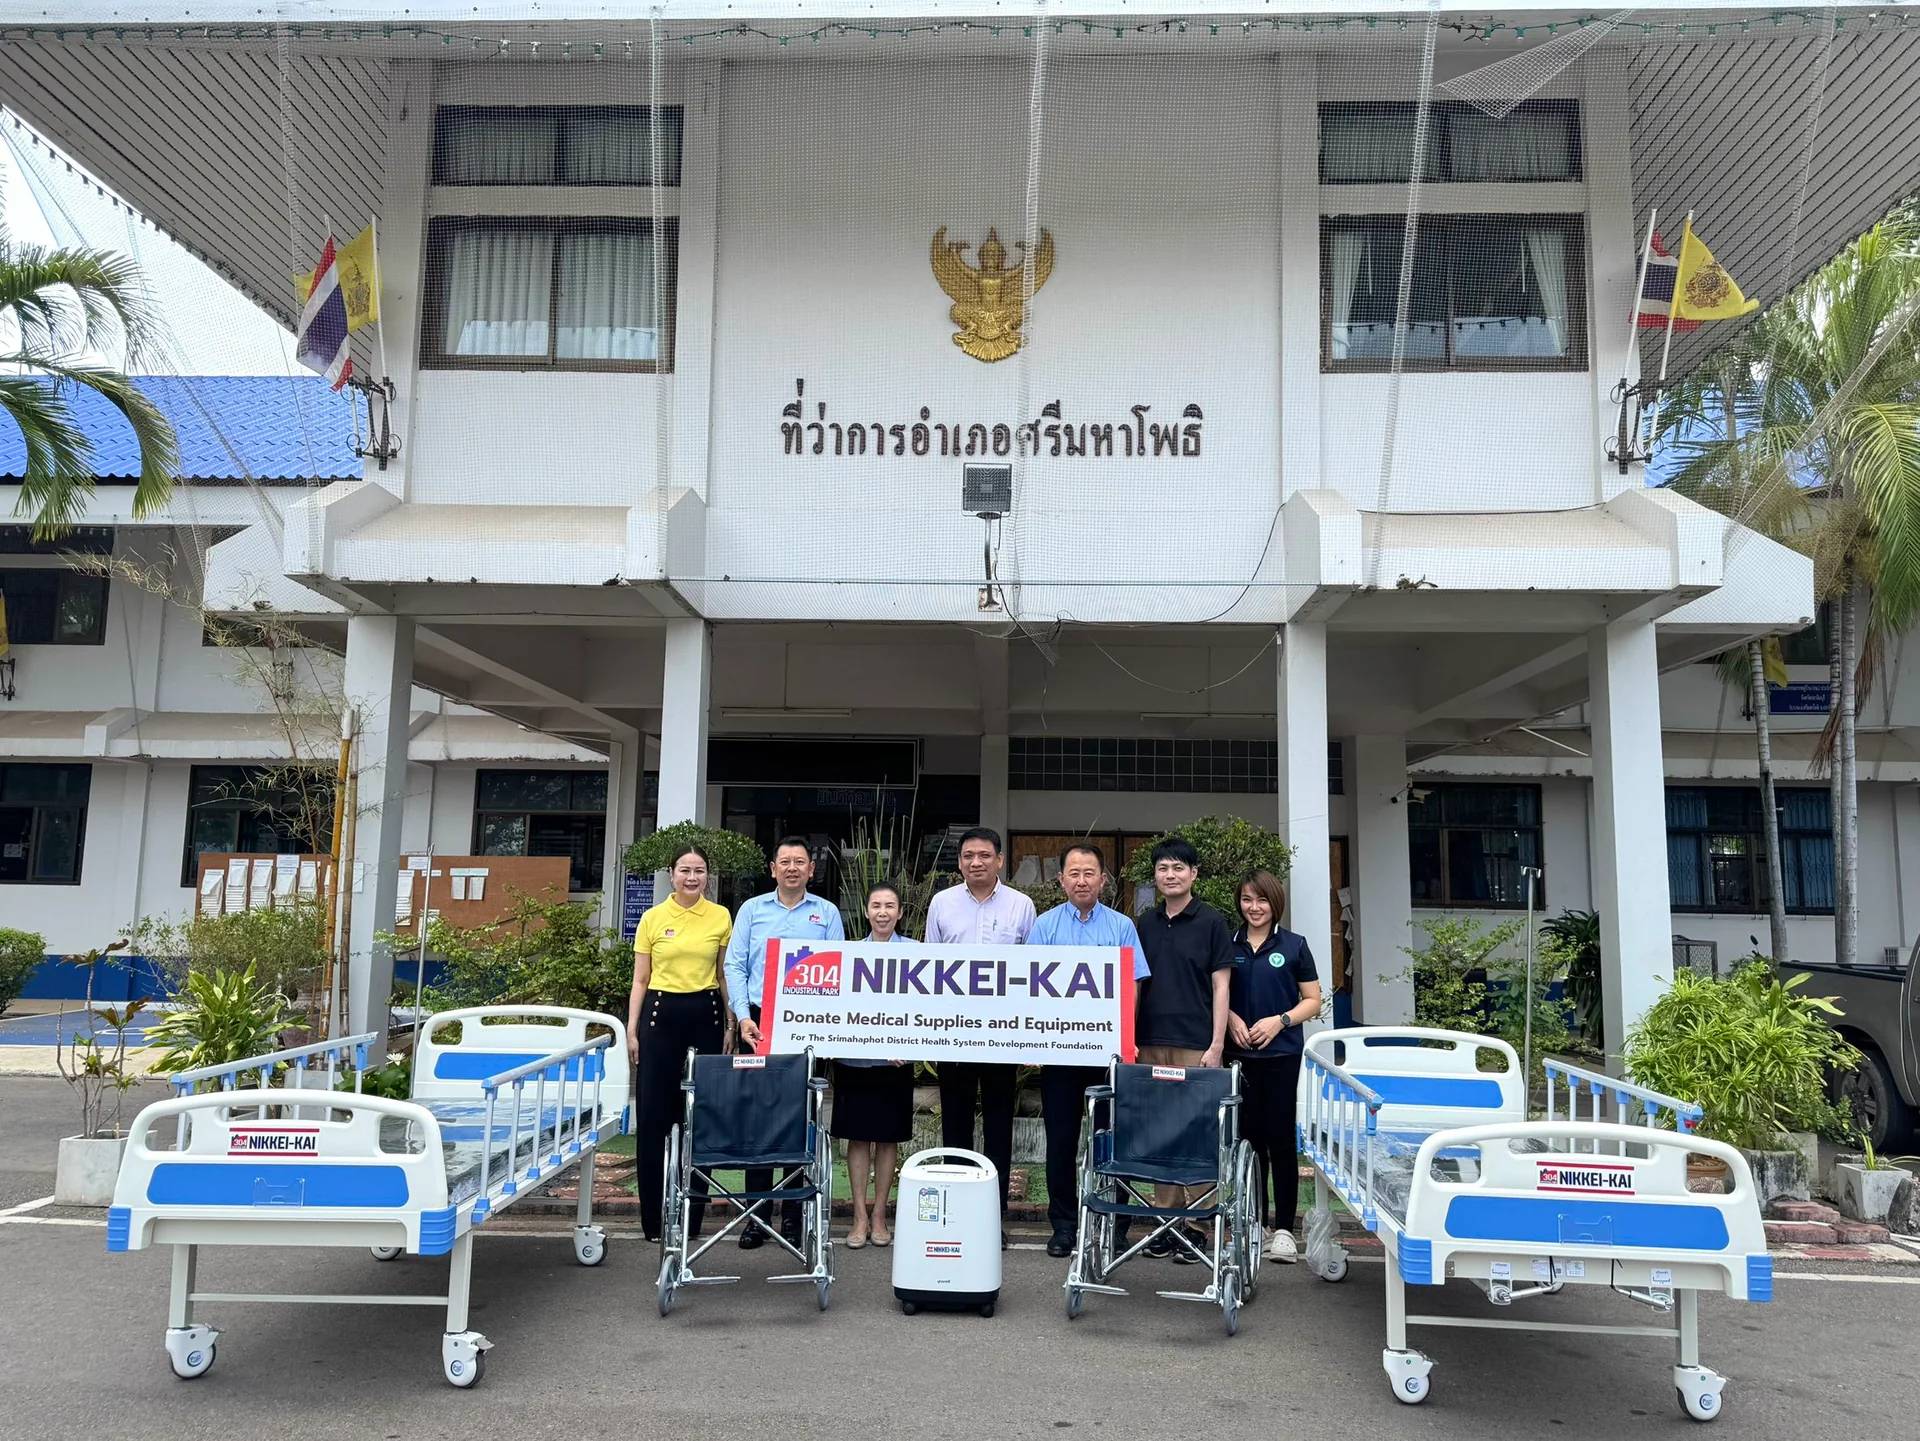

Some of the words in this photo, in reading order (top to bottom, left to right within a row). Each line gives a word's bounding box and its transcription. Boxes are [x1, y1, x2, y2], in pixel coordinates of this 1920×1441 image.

[781, 378, 1203, 456] ที่ว่าการอำเภอศรีมหาโพธิ
[794, 964, 840, 986] 304
[852, 957, 1114, 999] NIKKEI-KAI
[783, 986, 820, 995] INDUSTRIAL
[821, 987, 840, 996] PARK
[783, 1010, 841, 1025] Donate
[847, 1011, 909, 1026] Medical
[914, 1014, 982, 1031] Supplies
[988, 1016, 1019, 1030] and
[1025, 1017, 1113, 1034] Equipment
[791, 1033, 806, 1041] For
[809, 1034, 825, 1042] The
[828, 1034, 884, 1044] Srimahaphot
[887, 1036, 919, 1045] District
[921, 1037, 951, 1046] Health
[953, 1038, 986, 1048] System
[988, 1039, 1049, 1050] Development
[1051, 1041, 1103, 1051] Foundation
[249, 1135, 316, 1150] NIKKEI-KAI
[1542, 1173, 1557, 1181] 304
[1559, 1171, 1632, 1188] NIKKEI-KAI
